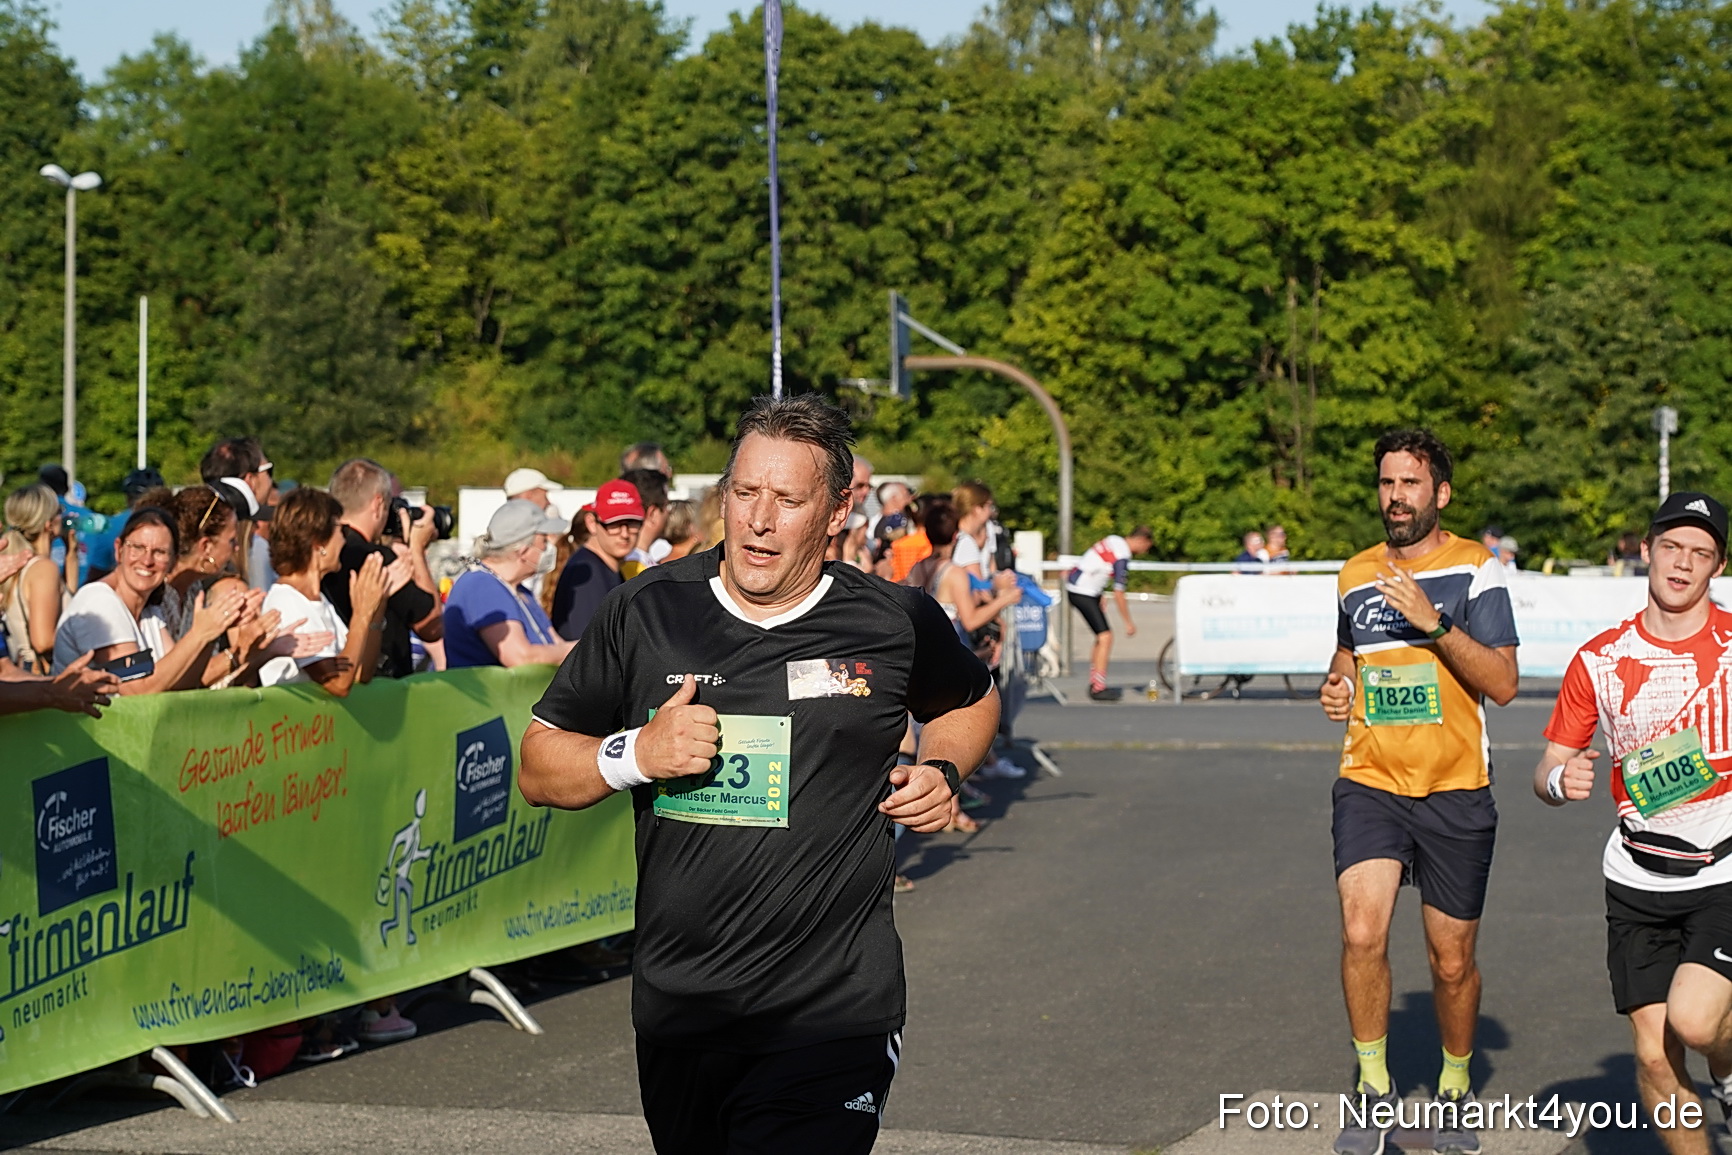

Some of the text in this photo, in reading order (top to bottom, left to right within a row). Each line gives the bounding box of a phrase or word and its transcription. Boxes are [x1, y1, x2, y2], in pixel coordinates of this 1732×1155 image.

[666, 674, 713, 684] CRFT
[1375, 685, 1427, 707] 1826
[1403, 706, 1428, 715] Daniel
[179, 713, 335, 793] Gesunde Firmen
[466, 754, 507, 785] Fischer
[690, 754, 751, 789] 23
[767, 761, 782, 811] 2022
[1639, 755, 1695, 793] 1108
[217, 748, 349, 841] laufen länger!
[666, 787, 717, 803] Schuster
[720, 792, 767, 805] Marcus
[1650, 786, 1684, 803] Hofmann
[1683, 778, 1700, 790] Leo
[48, 807, 97, 842] Fischer
[423, 807, 552, 906] firmenlauf
[9, 850, 196, 994] firmenlauf
[423, 889, 478, 934] neumarkt
[12, 971, 88, 1029] neumarkt
[132, 947, 346, 1030] www.firmenlauf-oberpfalz.de
[844, 1100, 876, 1113] adidas
